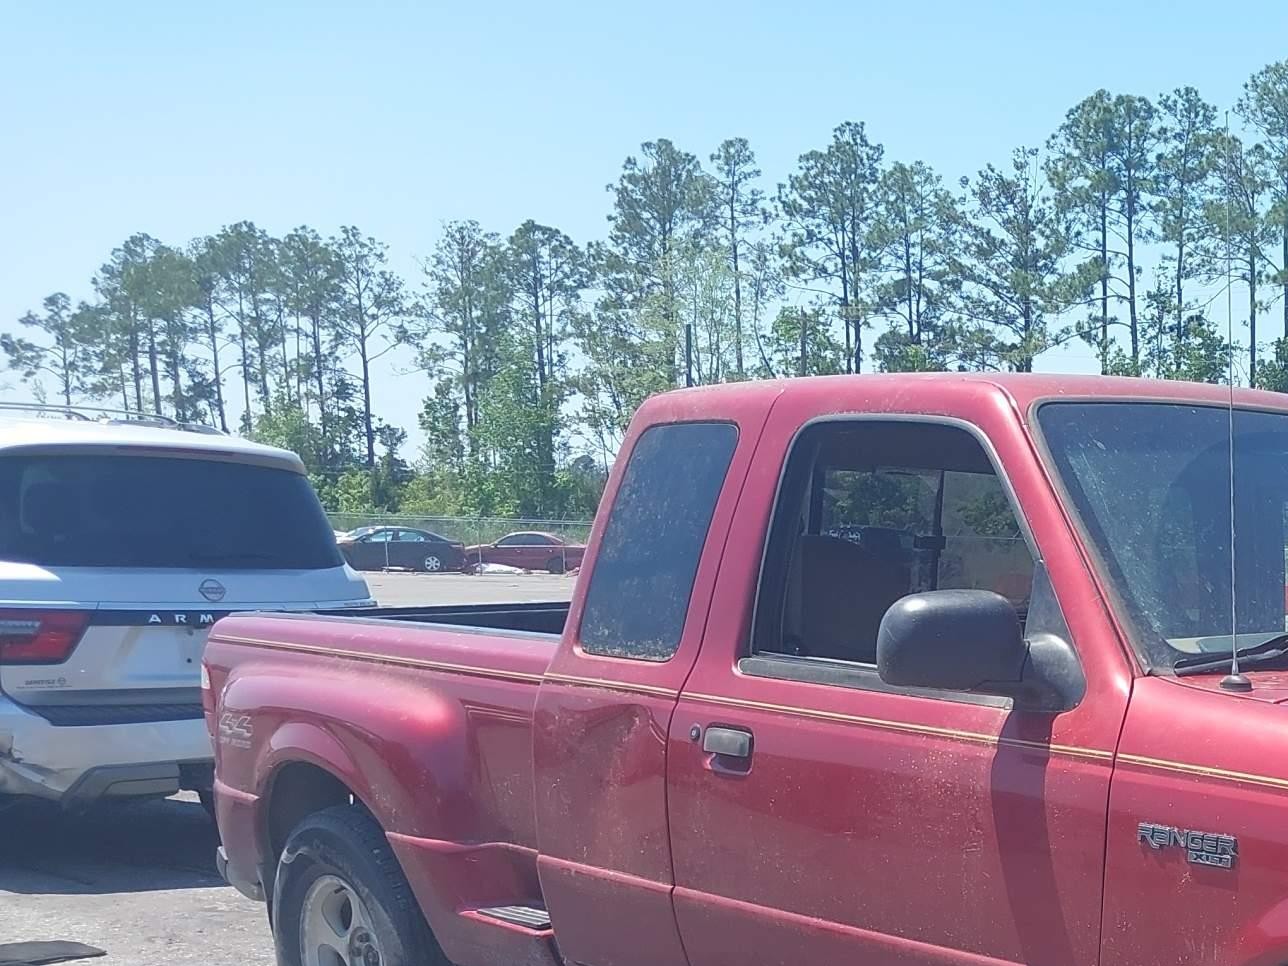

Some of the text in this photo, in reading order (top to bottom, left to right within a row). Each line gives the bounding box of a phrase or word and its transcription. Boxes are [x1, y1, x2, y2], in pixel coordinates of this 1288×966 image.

[147, 613, 215, 624] ARM
[1136, 821, 1239, 856] RANGER
[1191, 852, 1231, 867] XLT
